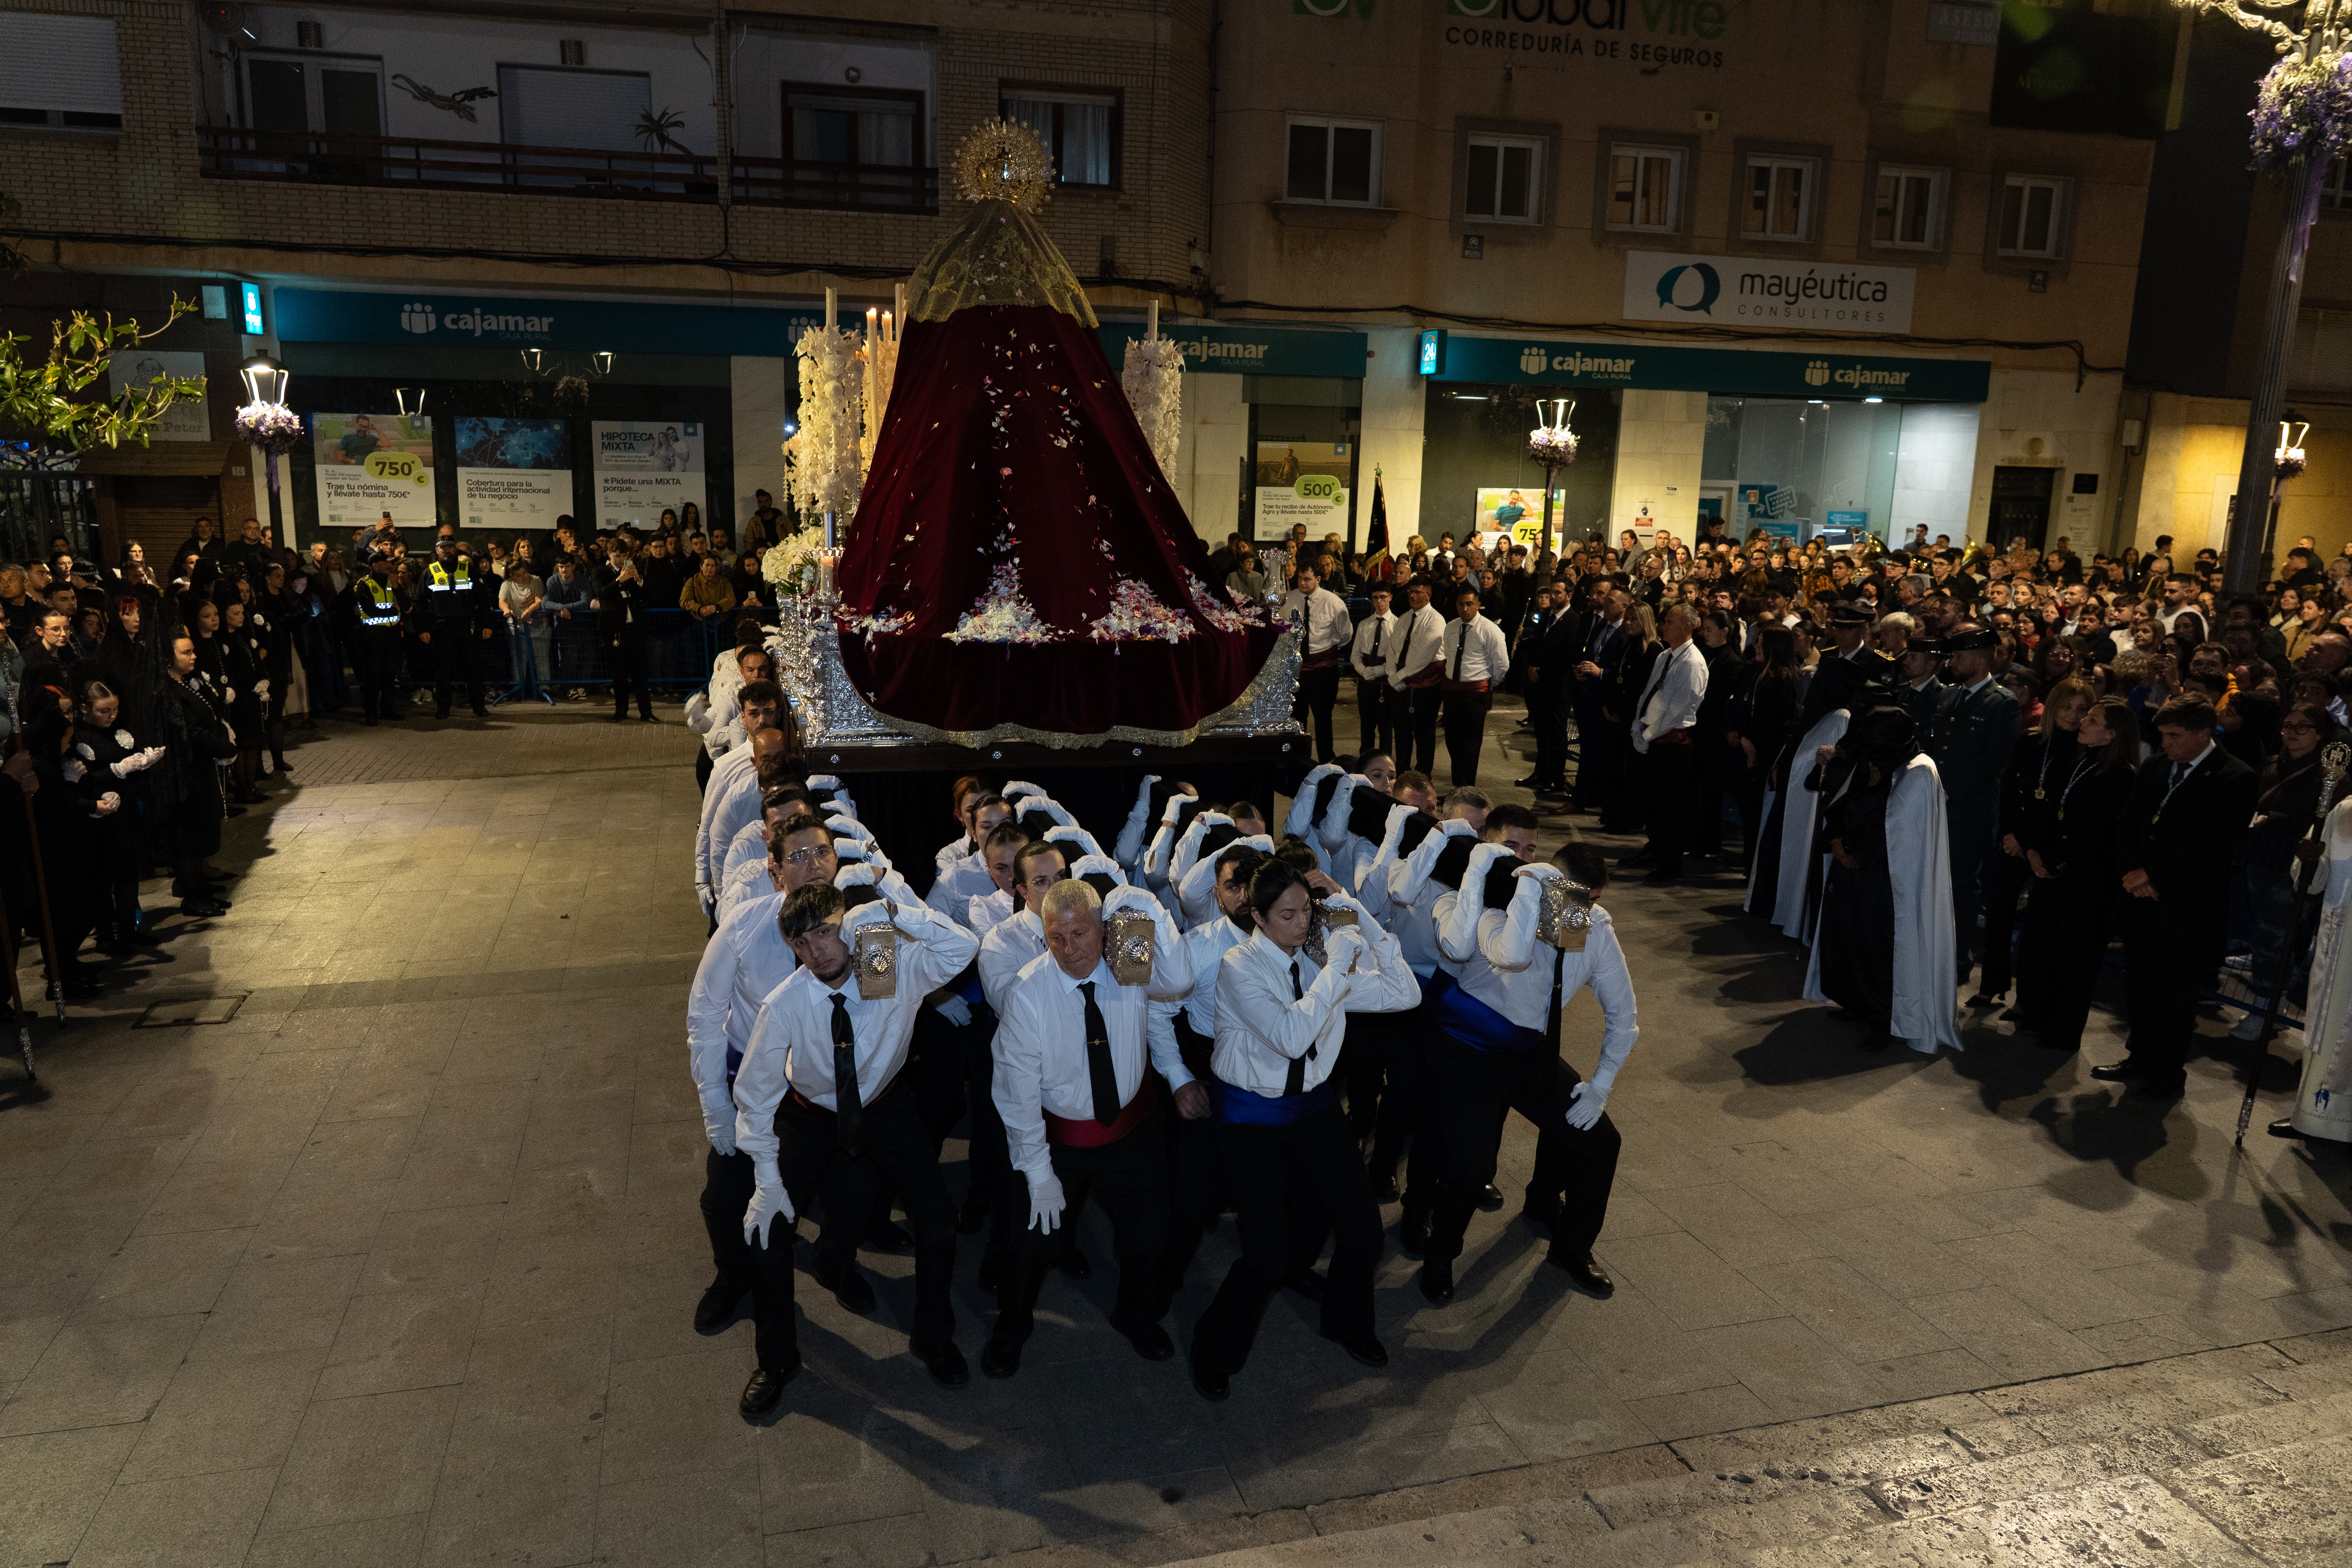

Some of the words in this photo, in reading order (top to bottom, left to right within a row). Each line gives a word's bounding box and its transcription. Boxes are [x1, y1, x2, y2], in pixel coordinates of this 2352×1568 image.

[1446, 27, 1583, 54] CORREDURÍA
[1595, 40, 1619, 58] DE
[1630, 44, 1723, 67] SEGUROS
[1739, 268, 1887, 306] mayéutica
[444, 308, 554, 336] cajamar
[1738, 305, 1886, 322] CONSULTORES
[1176, 336, 1269, 362] cajamar
[1552, 352, 1635, 377] cajamar
[1835, 365, 1910, 388] cajamar
[163, 422, 203, 432] Peter
[601, 432, 654, 441] HIPOTECA
[601, 442, 635, 451] MIXTA
